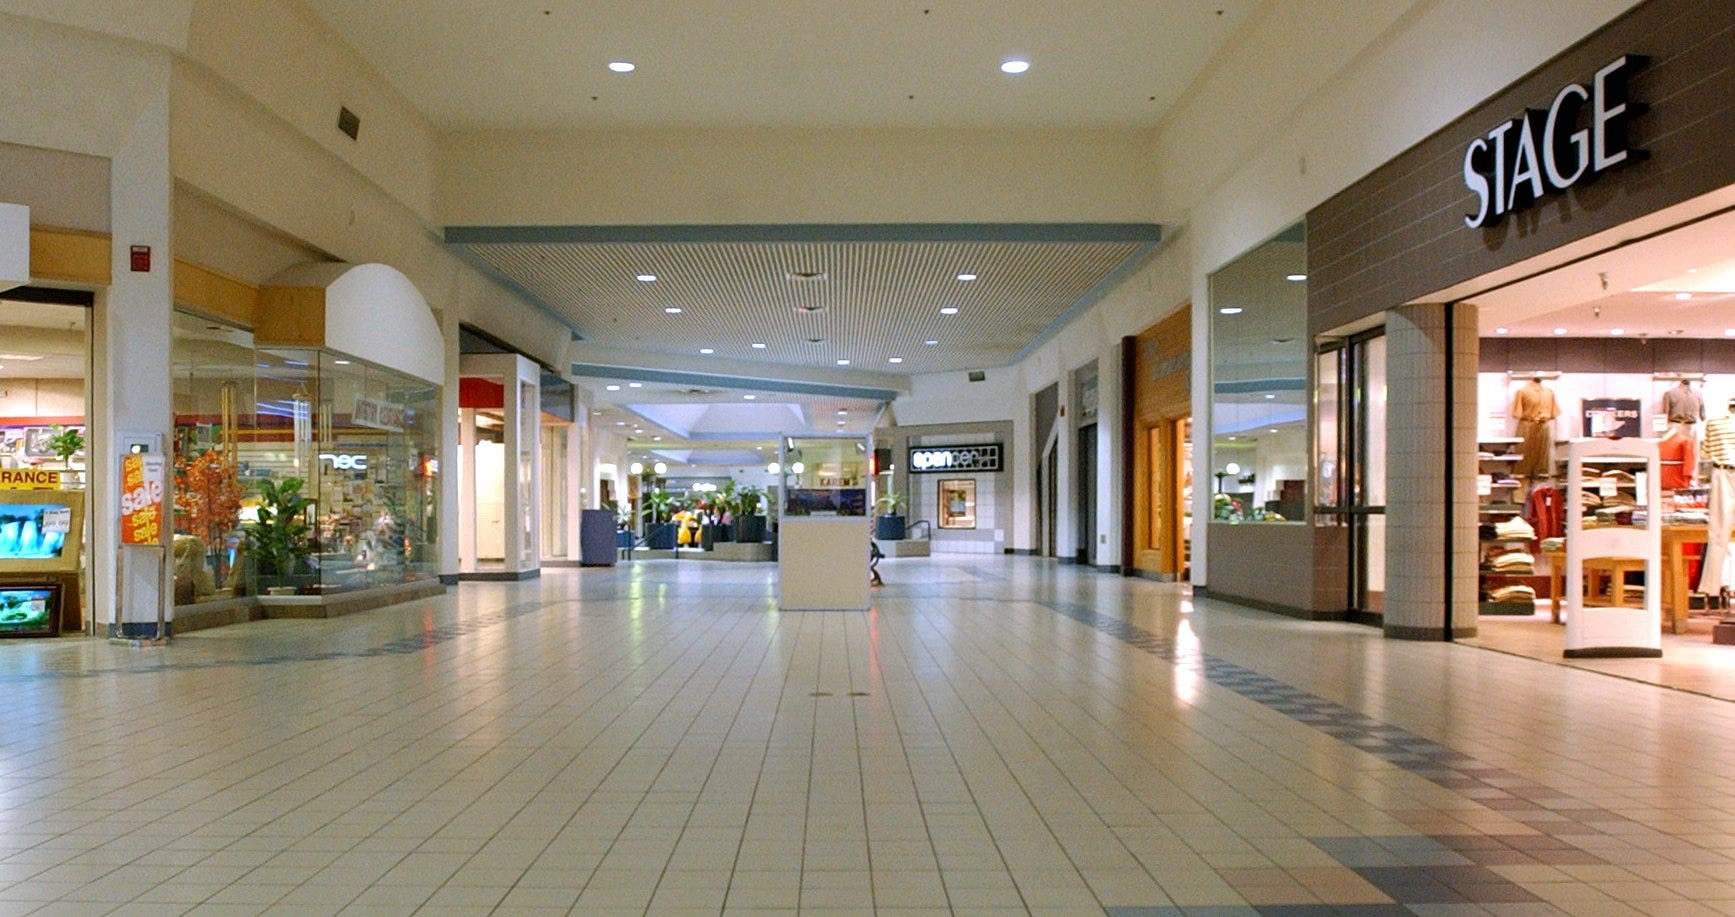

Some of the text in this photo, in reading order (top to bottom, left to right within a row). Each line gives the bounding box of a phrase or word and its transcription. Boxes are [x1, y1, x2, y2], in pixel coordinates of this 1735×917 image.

[1463, 56, 1627, 228] STAGE
[2, 471, 58, 484] RANCE
[121, 480, 162, 515] sale
[132, 504, 157, 527] sale
[133, 519, 158, 542] sale
